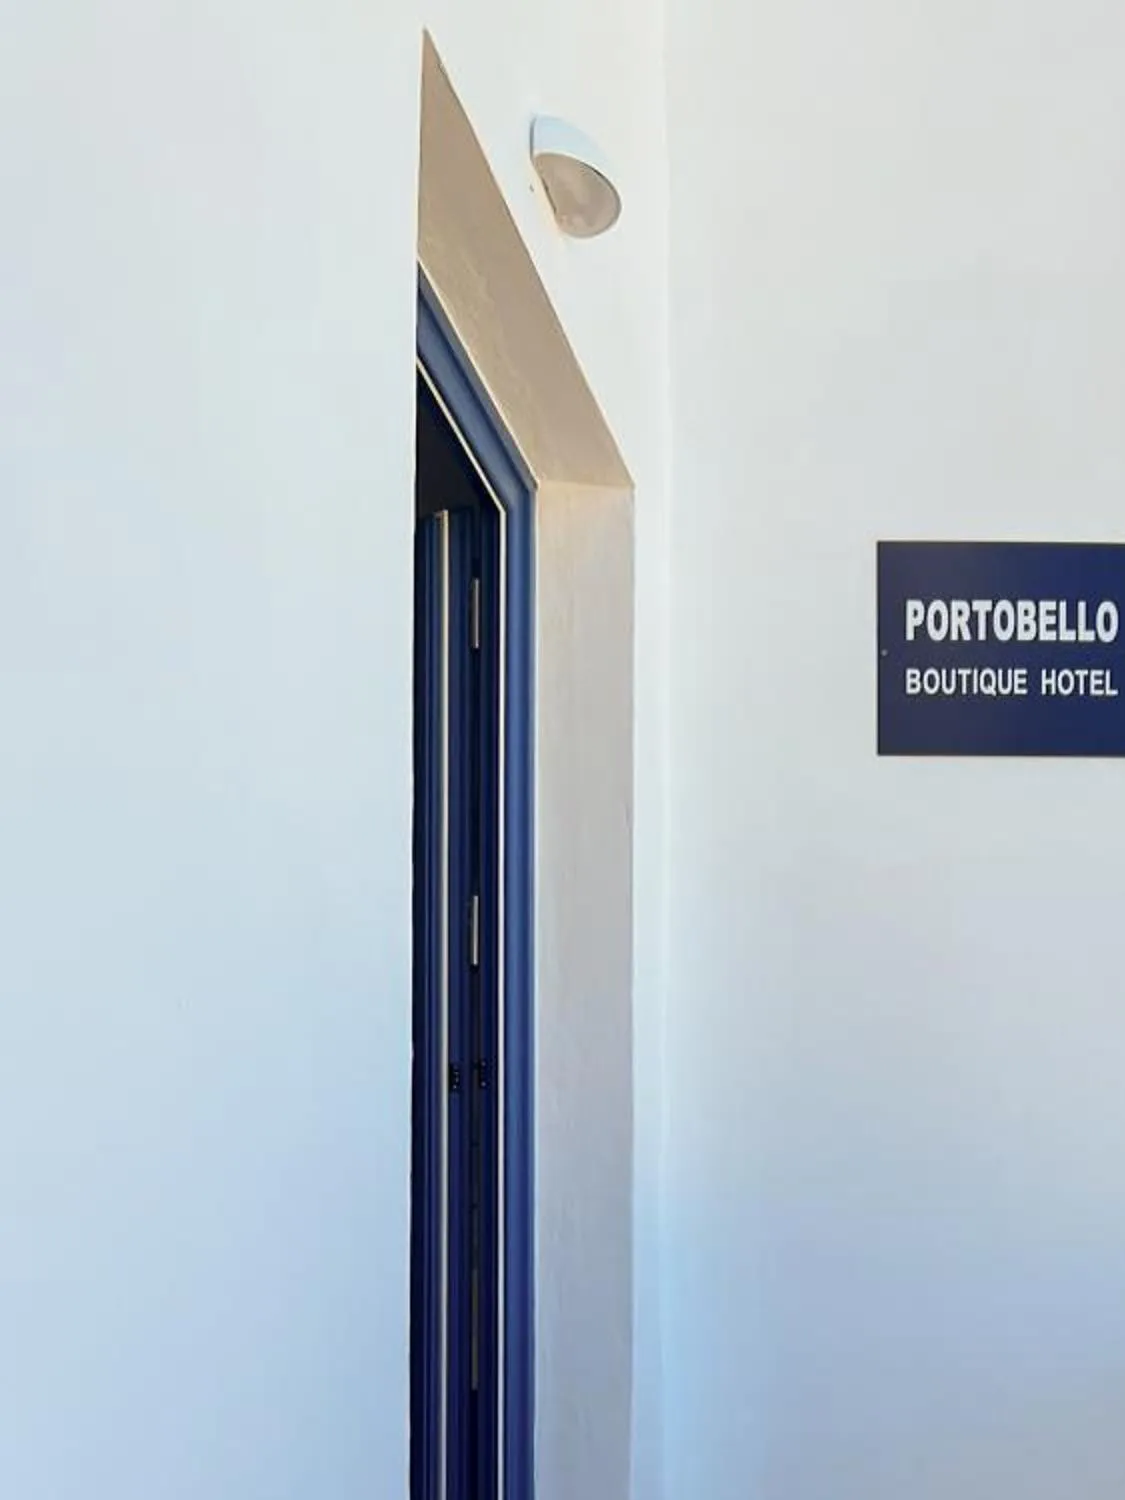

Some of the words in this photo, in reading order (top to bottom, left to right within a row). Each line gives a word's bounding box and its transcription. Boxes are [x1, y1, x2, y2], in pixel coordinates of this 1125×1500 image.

[905, 599, 1119, 642] PORTOBELLO
[906, 667, 1028, 696] BOUTIQUE
[1041, 668, 1119, 696] HOTEL
